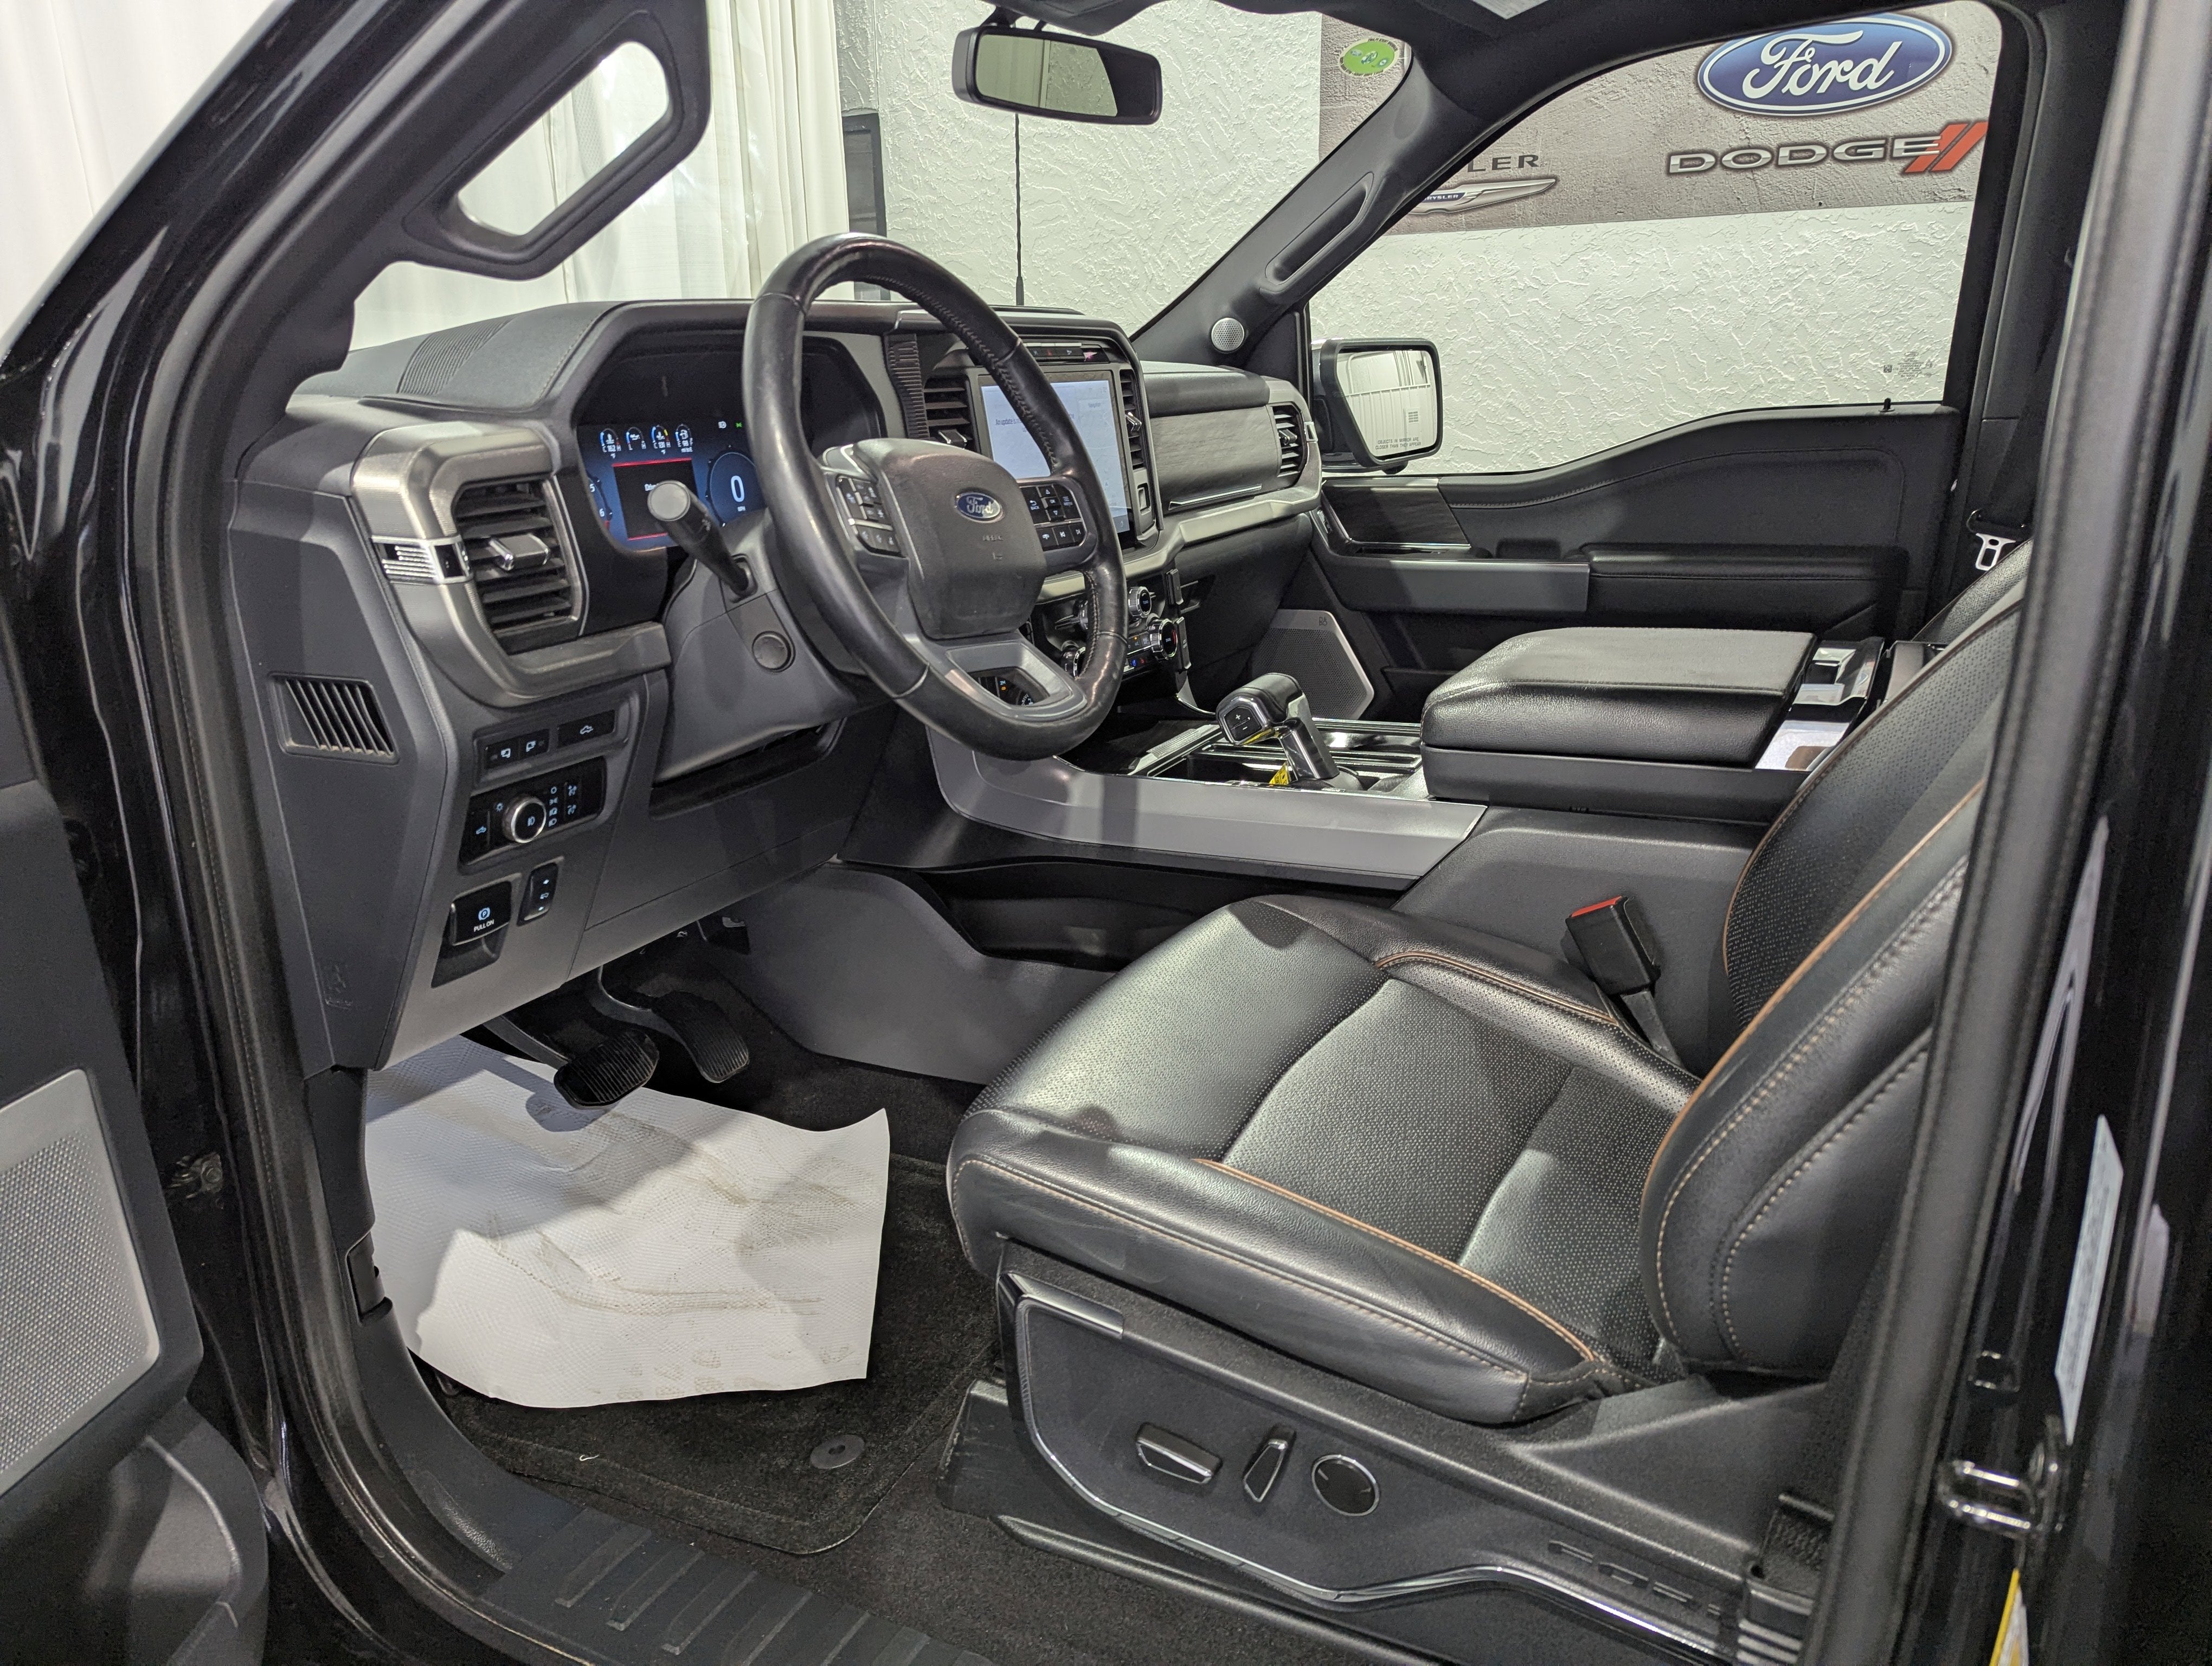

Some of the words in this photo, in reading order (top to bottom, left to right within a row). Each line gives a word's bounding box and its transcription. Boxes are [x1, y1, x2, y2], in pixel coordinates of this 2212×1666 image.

[1742, 30, 1902, 99] Ford
[1467, 155, 1539, 172] LER
[1669, 136, 1942, 174] DODGE
[590, 483, 595, 492] 5
[730, 475, 745, 502] 0
[599, 508, 605, 517] 6
[966, 496, 993, 514] Ford
[473, 923, 486, 932] PULL
[486, 919, 494, 927] ON
